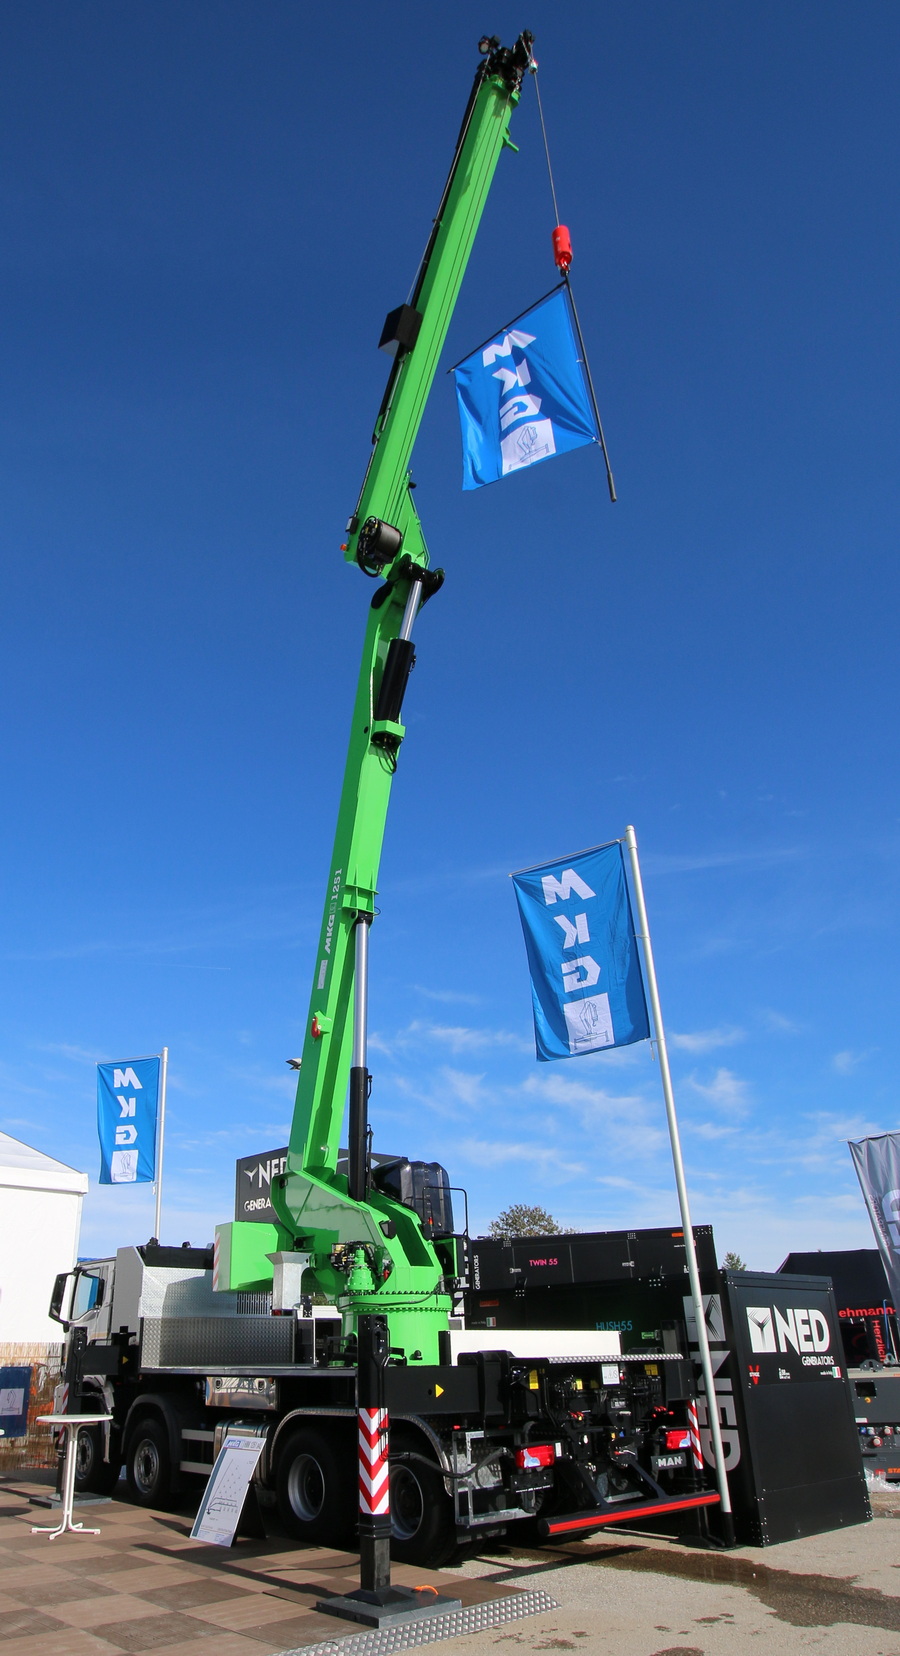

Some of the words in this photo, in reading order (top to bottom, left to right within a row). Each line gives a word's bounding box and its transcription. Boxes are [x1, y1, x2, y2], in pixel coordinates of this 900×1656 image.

[324, 914, 335, 955] MKG
[331, 868, 343, 901] 1251
[529, 1258, 547, 1267] TWIN
[548, 1257, 559, 1266] 55
[772, 1304, 831, 1356] NED
[871, 1319, 886, 1362] Herzlich
[801, 1355, 835, 1366] GENERATORS
[657, 1456, 682, 1467] MAN
